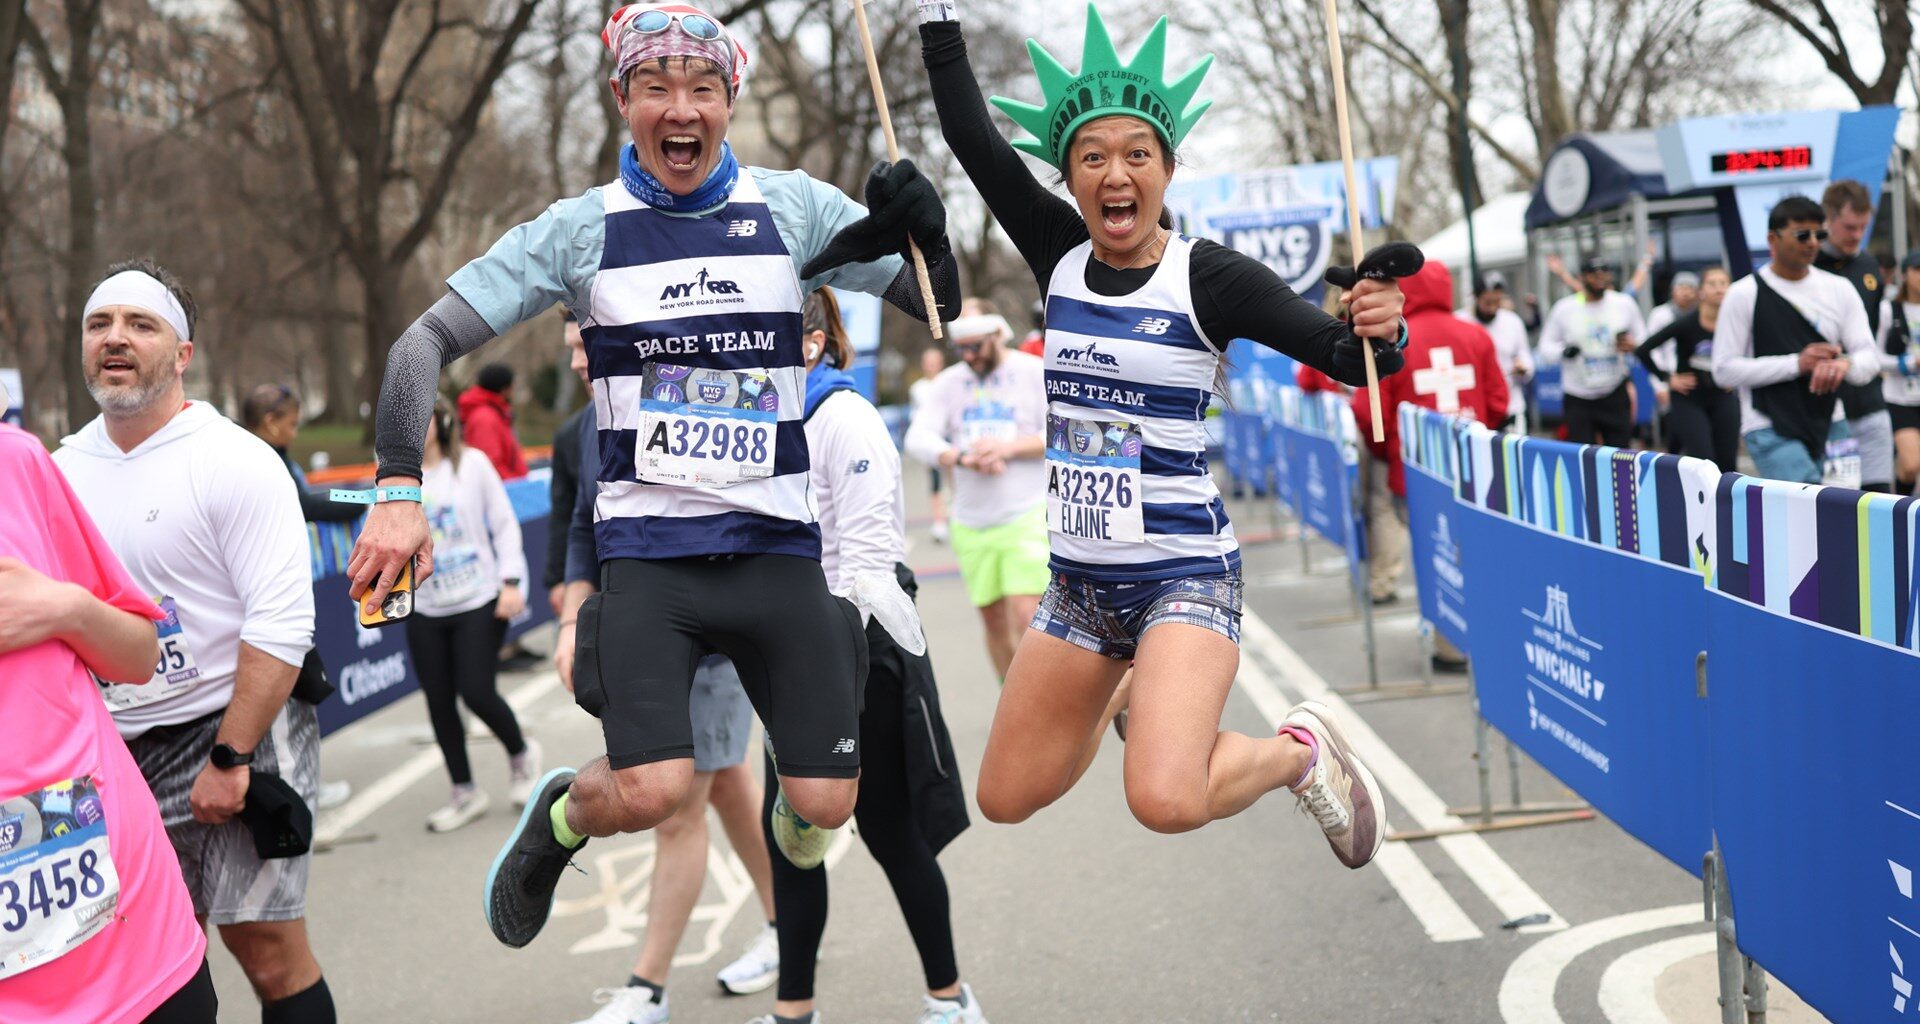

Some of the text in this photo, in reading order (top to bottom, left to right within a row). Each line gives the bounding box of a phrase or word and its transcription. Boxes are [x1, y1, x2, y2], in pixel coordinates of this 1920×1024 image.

[1066, 70, 1149, 94] STATUE OF LIBERTY
[1232, 224, 1311, 259] NYC
[634, 331, 775, 359] PACE TEAM
[1096, 366, 1120, 374] RUNNERS
[703, 386, 721, 394] NYC
[1047, 379, 1145, 407] PACE TEAM
[742, 468, 764, 477] WAVE
[1062, 503, 1112, 540] ELAINE
[168, 671, 190, 682] WAVE
[1535, 643, 1592, 699] NYCHALF
[79, 900, 110, 921] WAVE
